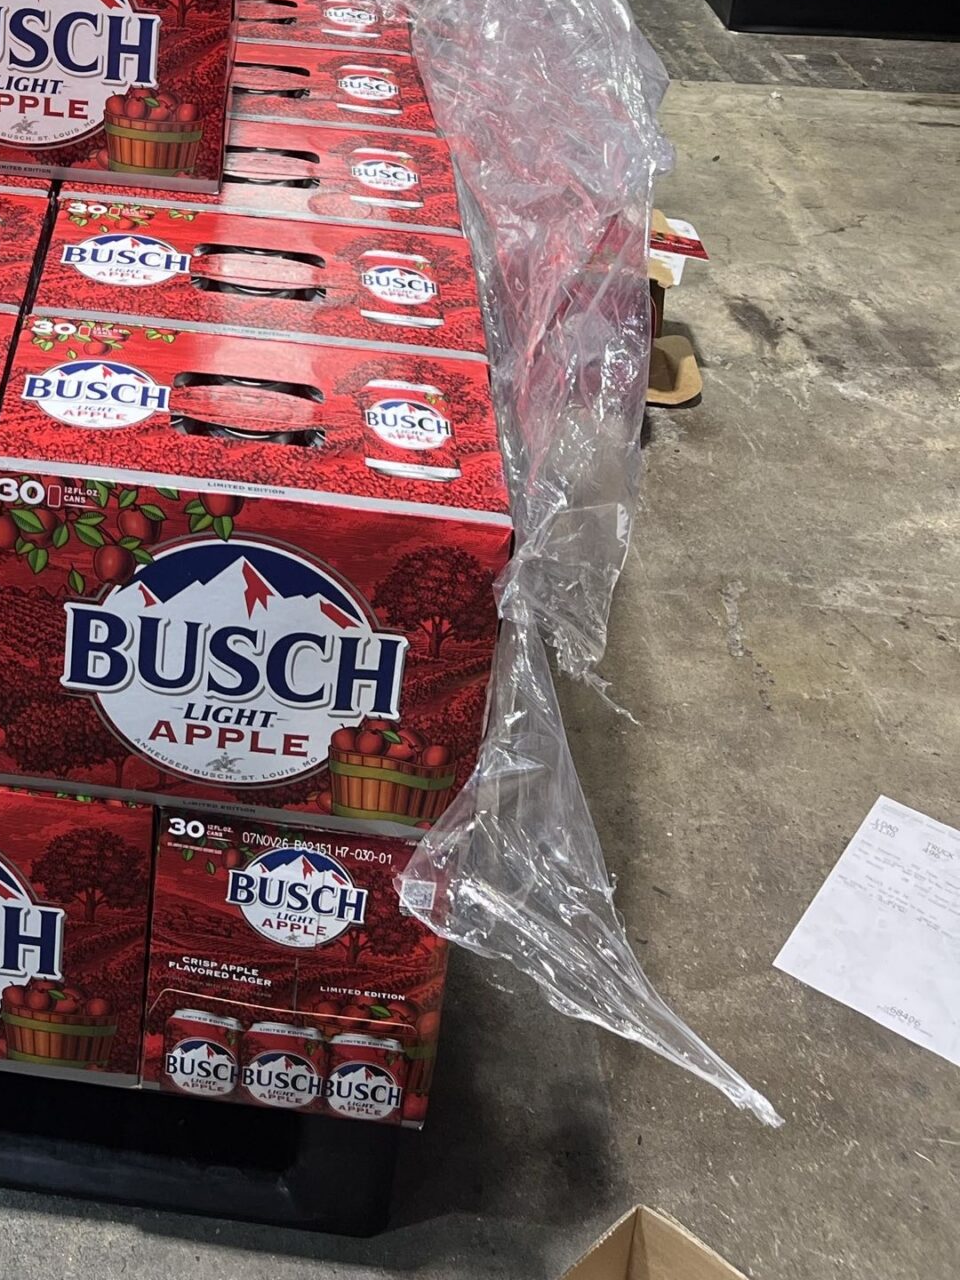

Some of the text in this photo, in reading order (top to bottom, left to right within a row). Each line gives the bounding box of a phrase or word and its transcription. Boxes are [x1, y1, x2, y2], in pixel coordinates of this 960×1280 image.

[325, 8, 378, 22] BUSCH
[339, 80, 398, 94] BUSCH
[352, 167, 418, 184] BUSCH
[67, 202, 108, 215] 30
[64, 246, 188, 271] BUSCH
[96, 271, 153, 281] APPLE
[362, 274, 437, 294] BUSCH
[31, 319, 77, 335] 30
[25, 377, 168, 409] BUSCH
[63, 409, 128, 420] APPLE
[366, 411, 451, 436] BUSCH
[208, 482, 285, 495] LIMITED EDITION
[63, 495, 87, 504] CANS
[66, 607, 404, 715] BUSCH
[183, 702, 278, 728] LIGHT
[148, 720, 310, 757] APPLE
[168, 817, 205, 839] 30
[242, 832, 289, 849] 07NOV26
[335, 846, 393, 865] H7-030-01
[229, 873, 368, 922] BUSCH
[261, 918, 327, 937] APPLE
[276, 911, 316, 926] LIGHT
[168, 961, 272, 987] FLAVORED LAGER
[182, 956, 259, 976] CRISP APPLE
[320, 986, 406, 1001] LIMITED EDITION
[166, 1055, 239, 1083] BUSCH
[182, 1083, 225, 1093] APPLE
[242, 1067, 323, 1096] BUSCH
[258, 1093, 303, 1105] APPLE
[323, 1079, 402, 1108] BUSCH
[339, 1105, 382, 1117] APPLE
